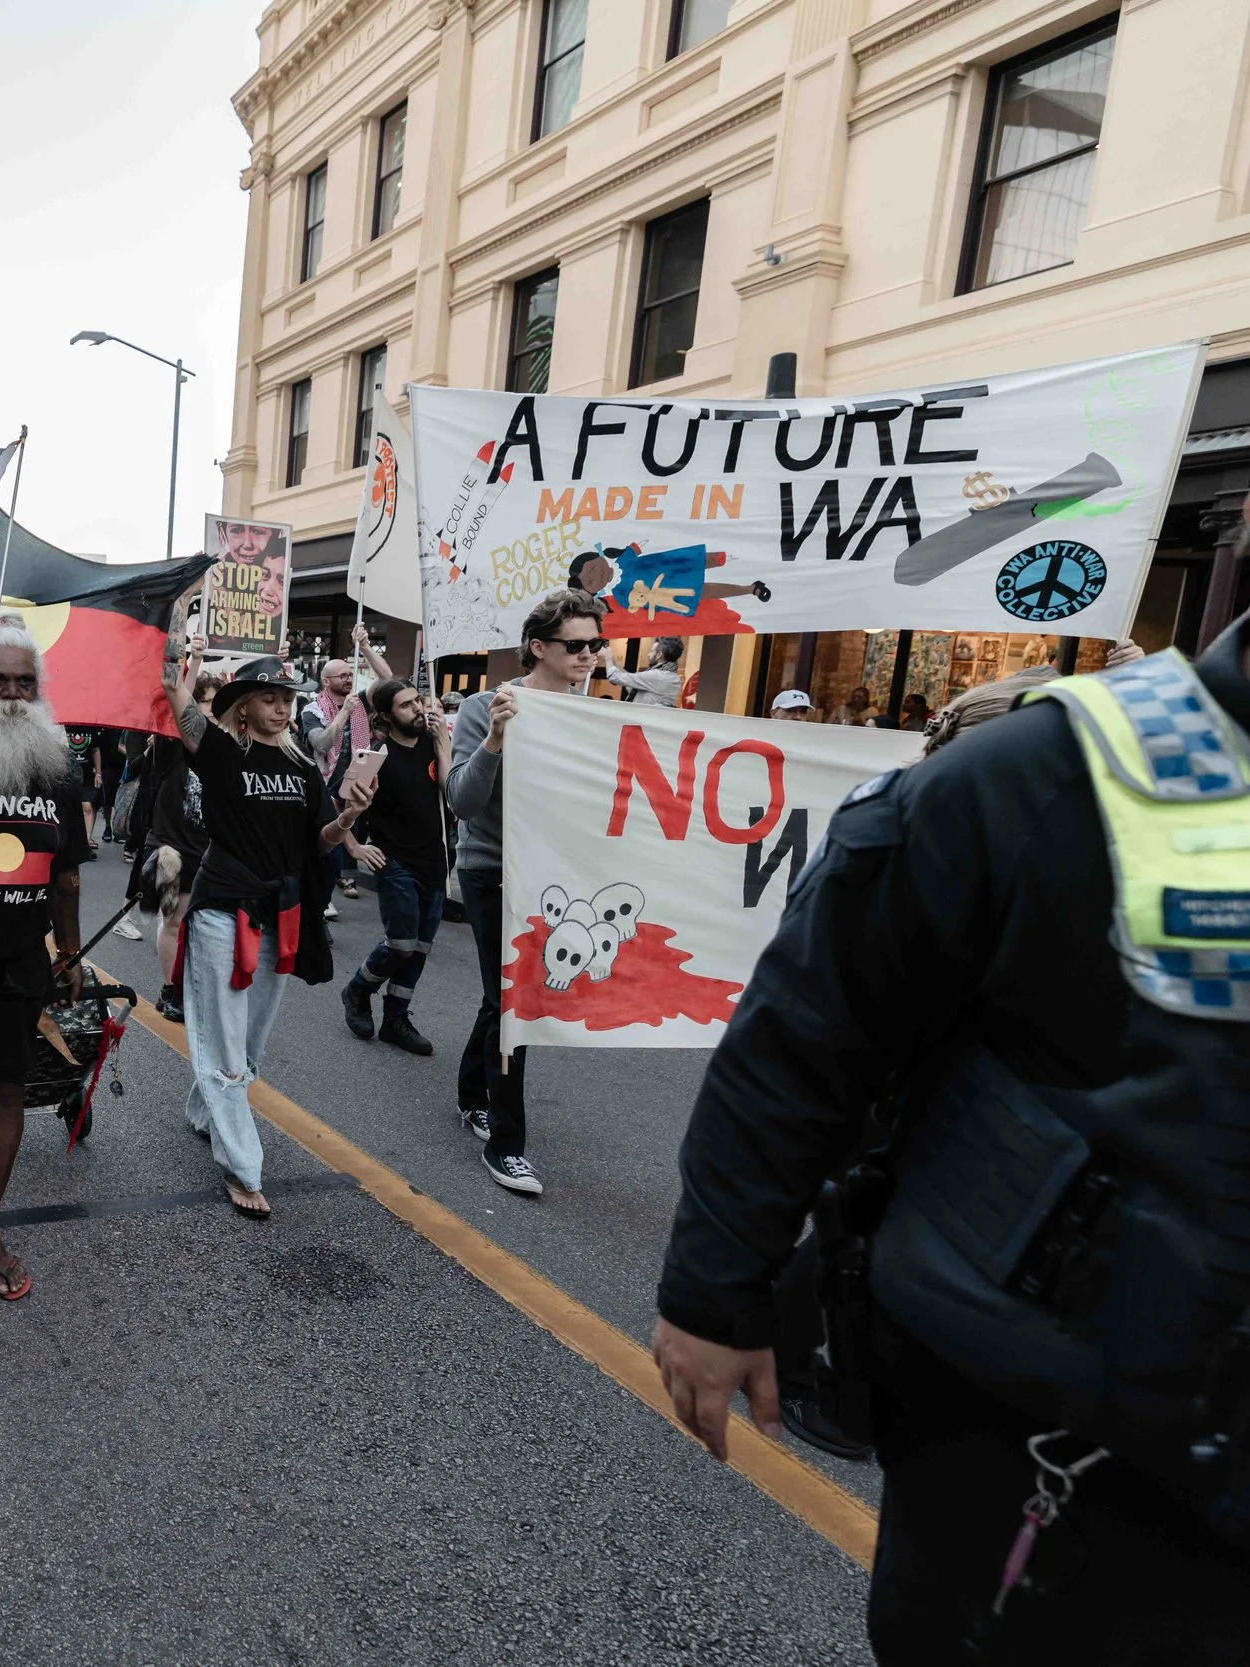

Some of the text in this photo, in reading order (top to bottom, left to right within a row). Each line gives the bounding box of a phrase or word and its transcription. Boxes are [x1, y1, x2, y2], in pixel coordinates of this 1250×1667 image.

[486, 384, 989, 484] A FUTURE
[446, 475, 478, 534] COLLIE
[536, 483, 745, 524] MADE IN
[780, 476, 922, 562] WA
[462, 504, 488, 549] BOUND
[490, 519, 584, 581] ROGER
[1005, 542, 1106, 581] WA ANTI-WAR
[212, 561, 263, 591] STOP
[210, 590, 260, 612] ARMING
[997, 575, 1103, 621] COLLECTIVE
[208, 609, 276, 641] ISRAEL
[242, 642, 264, 651] green
[241, 771, 307, 797] YAMAT
[606, 723, 787, 845] NO
[4, 890, 33, 904] WILL
